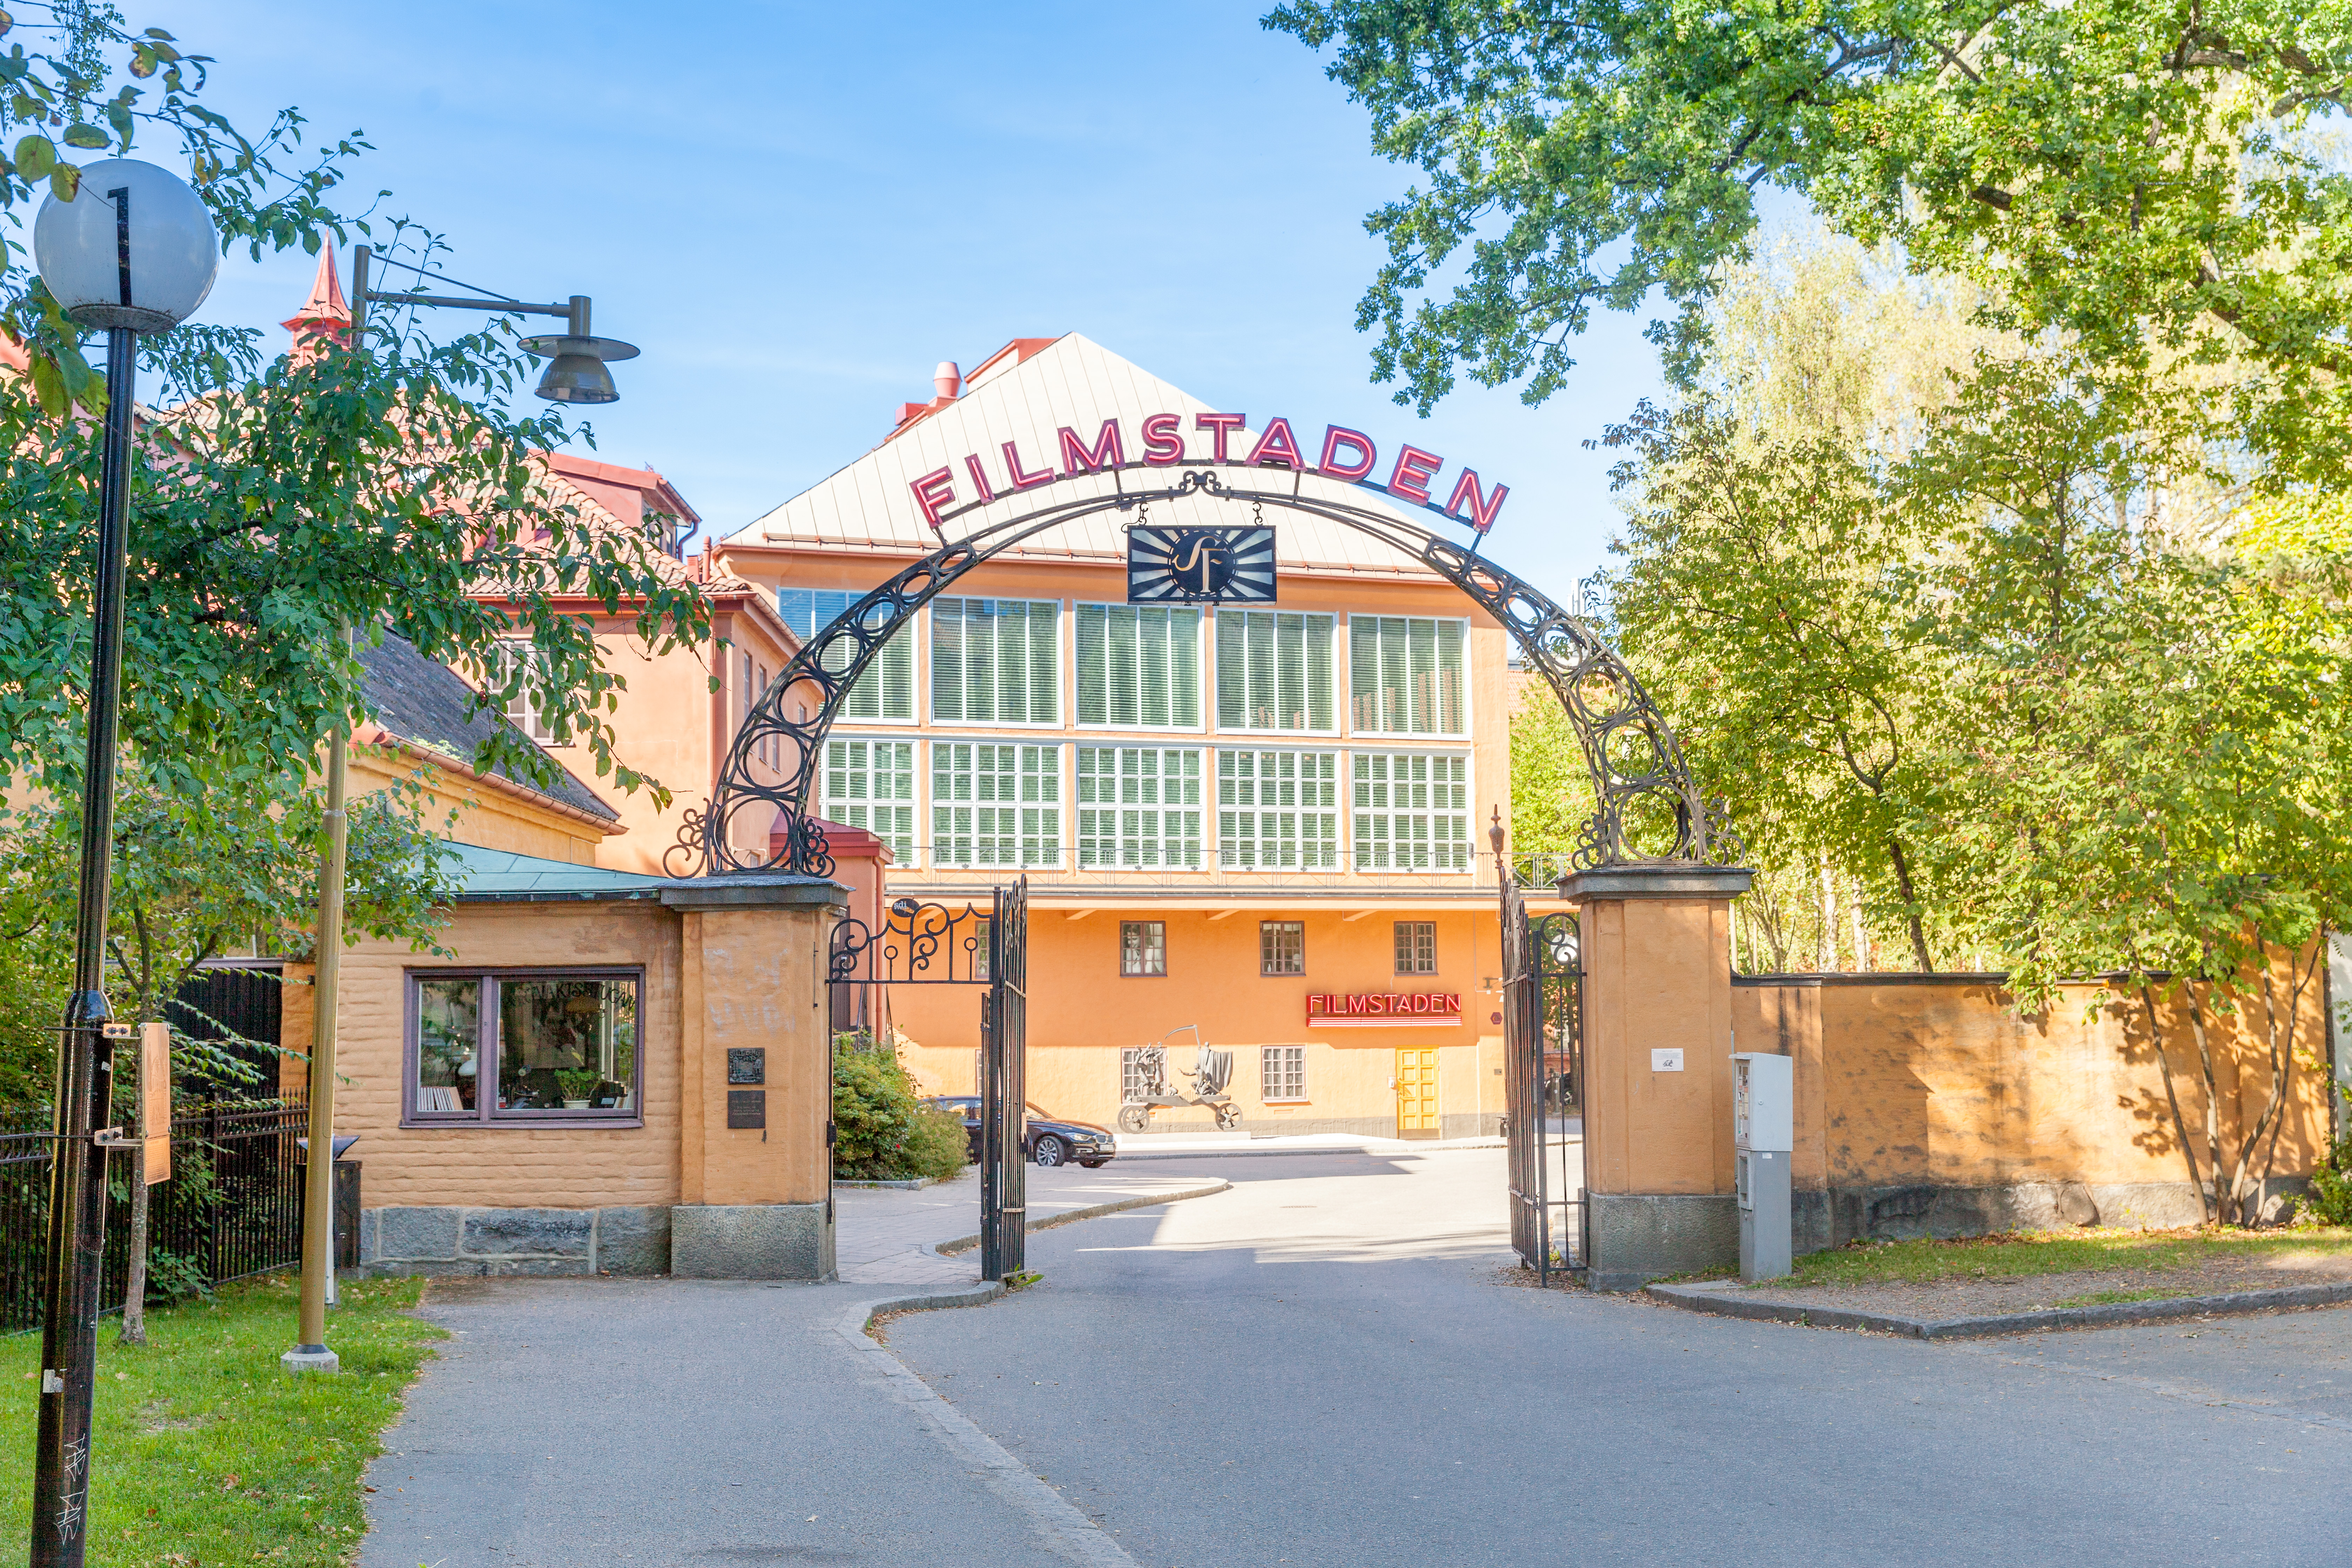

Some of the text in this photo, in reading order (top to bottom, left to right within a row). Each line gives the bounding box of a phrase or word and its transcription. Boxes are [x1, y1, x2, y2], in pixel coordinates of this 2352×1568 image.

[107, 186, 132, 306] 1
[910, 413, 1510, 535] FILMSTADEN
[1307, 994, 1461, 1013] FILMSTADEN
